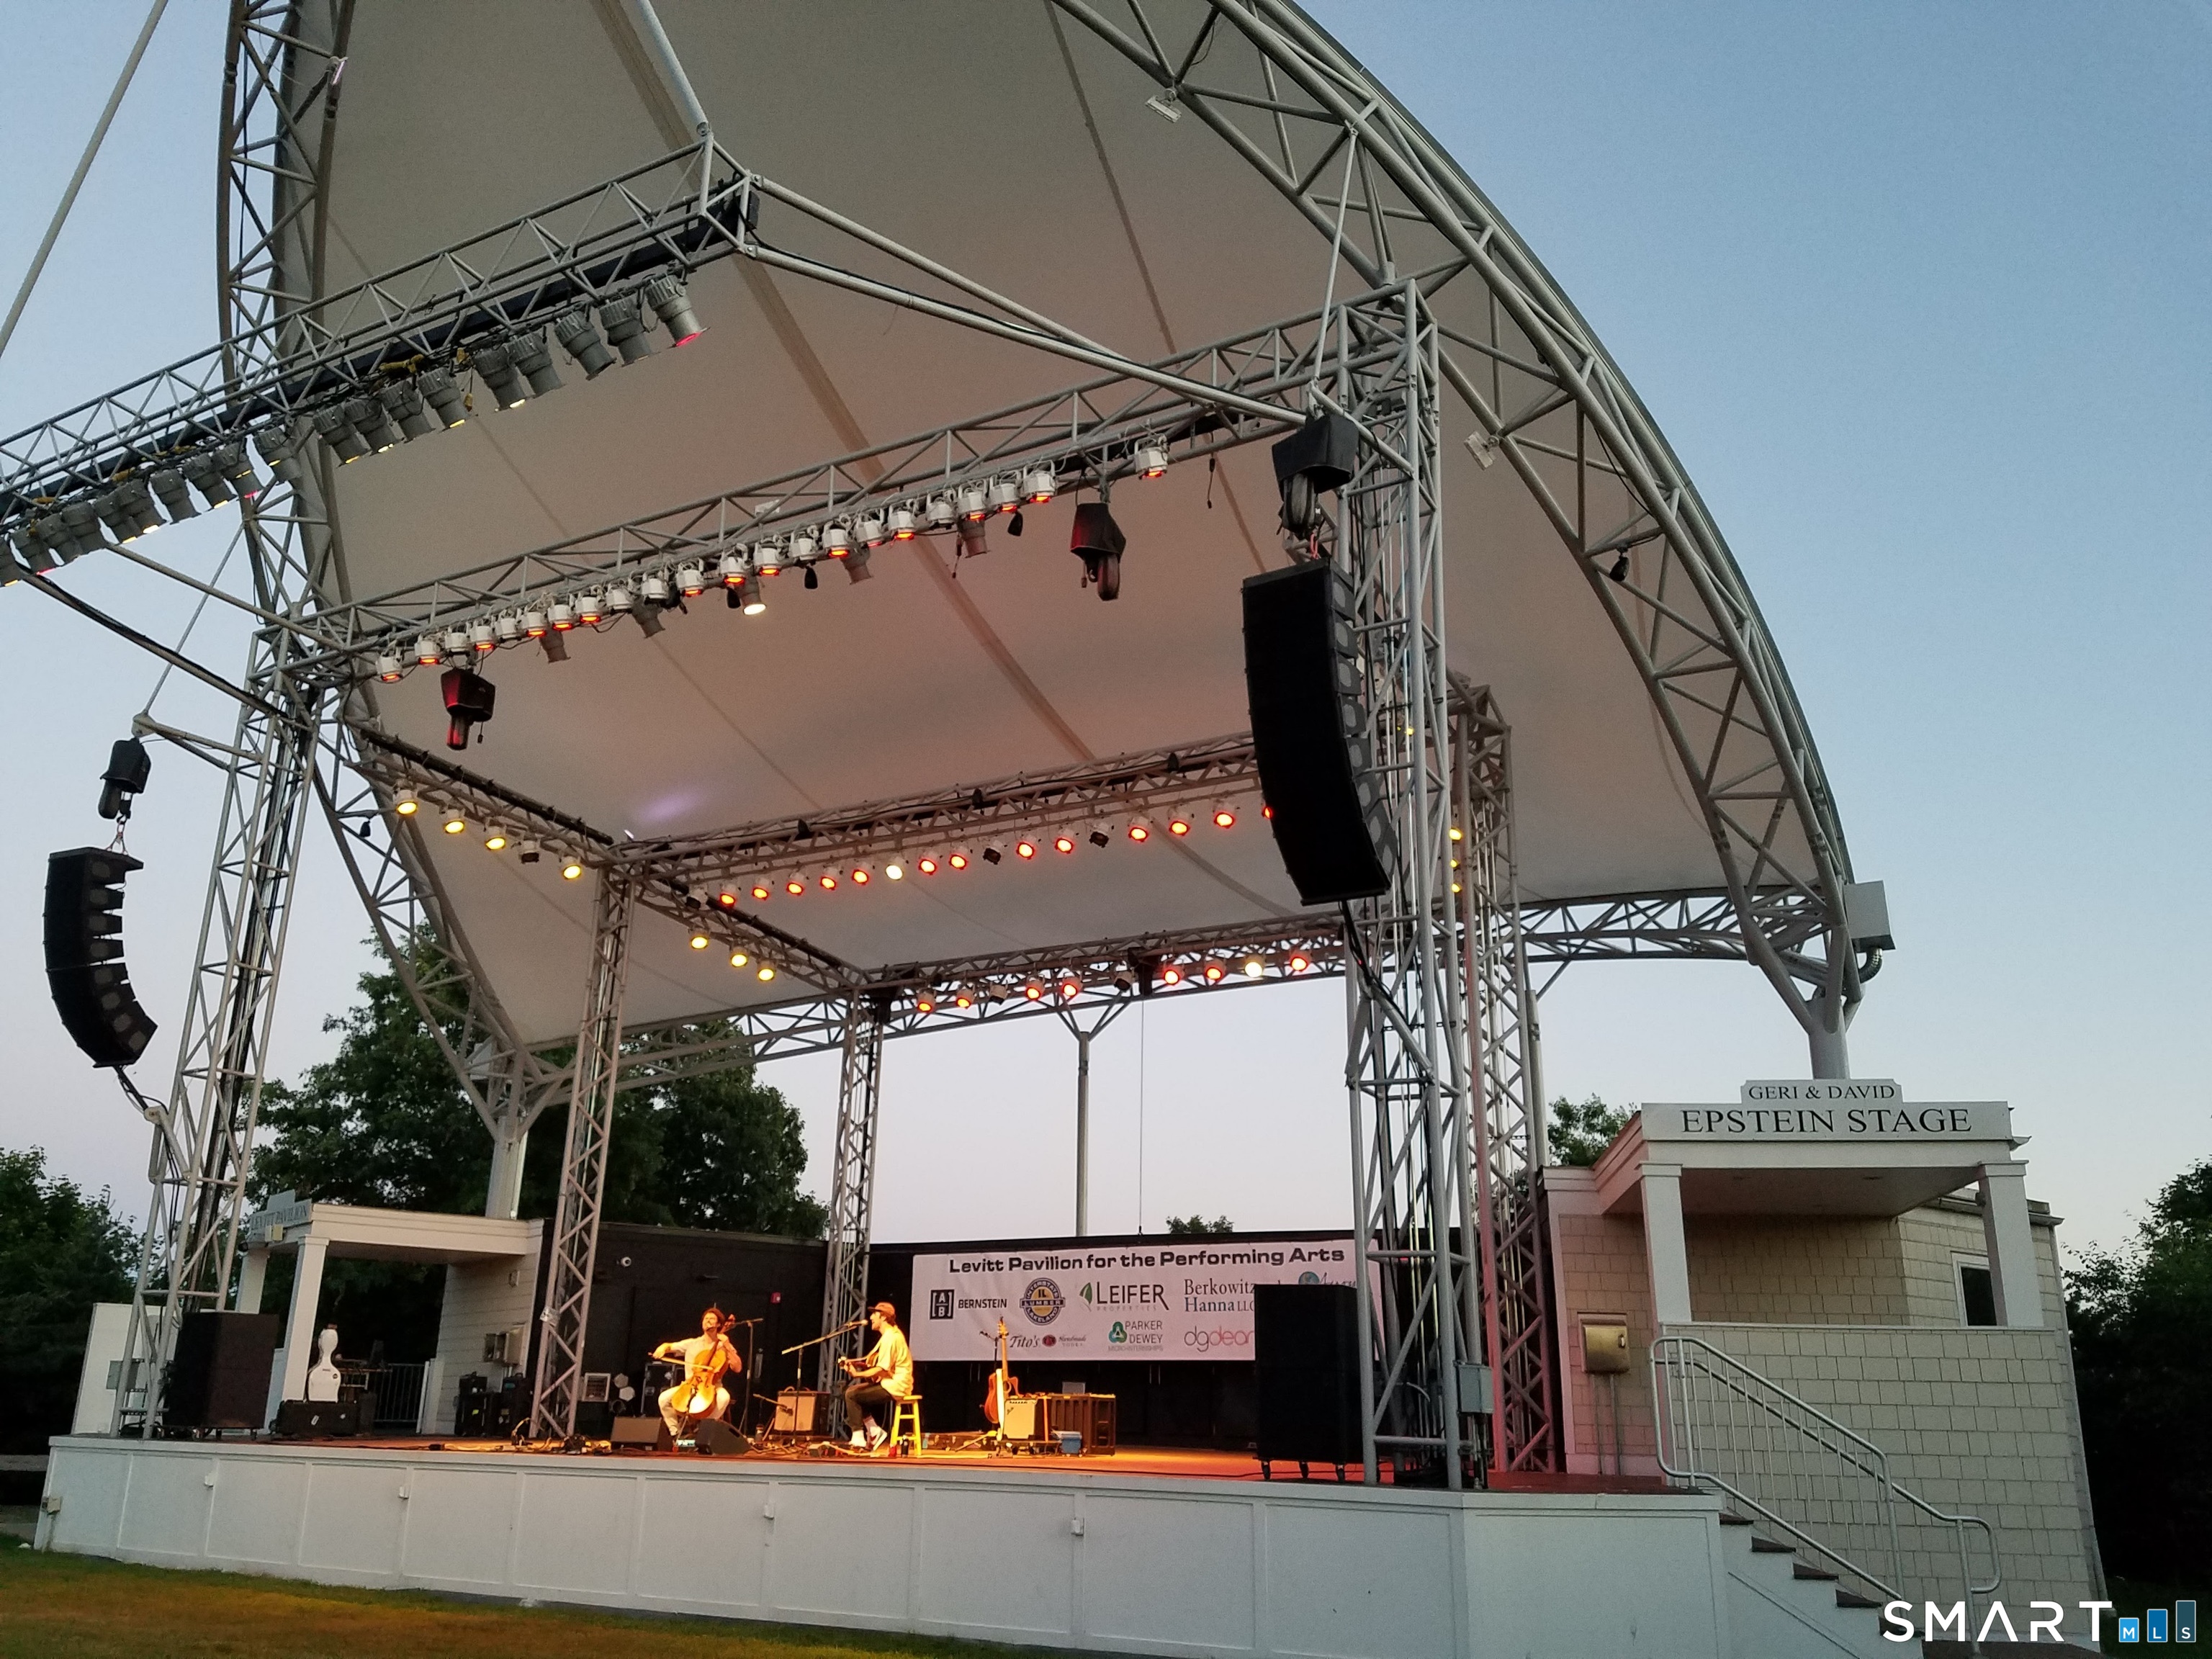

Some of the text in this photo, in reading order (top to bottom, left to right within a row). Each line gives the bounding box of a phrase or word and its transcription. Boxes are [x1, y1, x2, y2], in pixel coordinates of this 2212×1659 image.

[1748, 1084, 1895, 1100] GERI & DAVID
[1681, 1108, 1972, 1133] EPSTEIN STAGE
[949, 1248, 1344, 1273] Levitt Pavilion for the Performing Arts
[1026, 1281, 1058, 1299] INTERSTATE
[1184, 1277, 1255, 1295] Berkowitz
[958, 1298, 1007, 1309] BERNSTEIN
[1097, 1282, 1169, 1310] LEIFER
[1184, 1297, 1235, 1311] Hanna
[1026, 1306, 1058, 1323] LAKELAND
[1125, 1321, 1163, 1330] PARKER
[1010, 1335, 1040, 1348] Tito's
[1129, 1334, 1163, 1344] DEWEY
